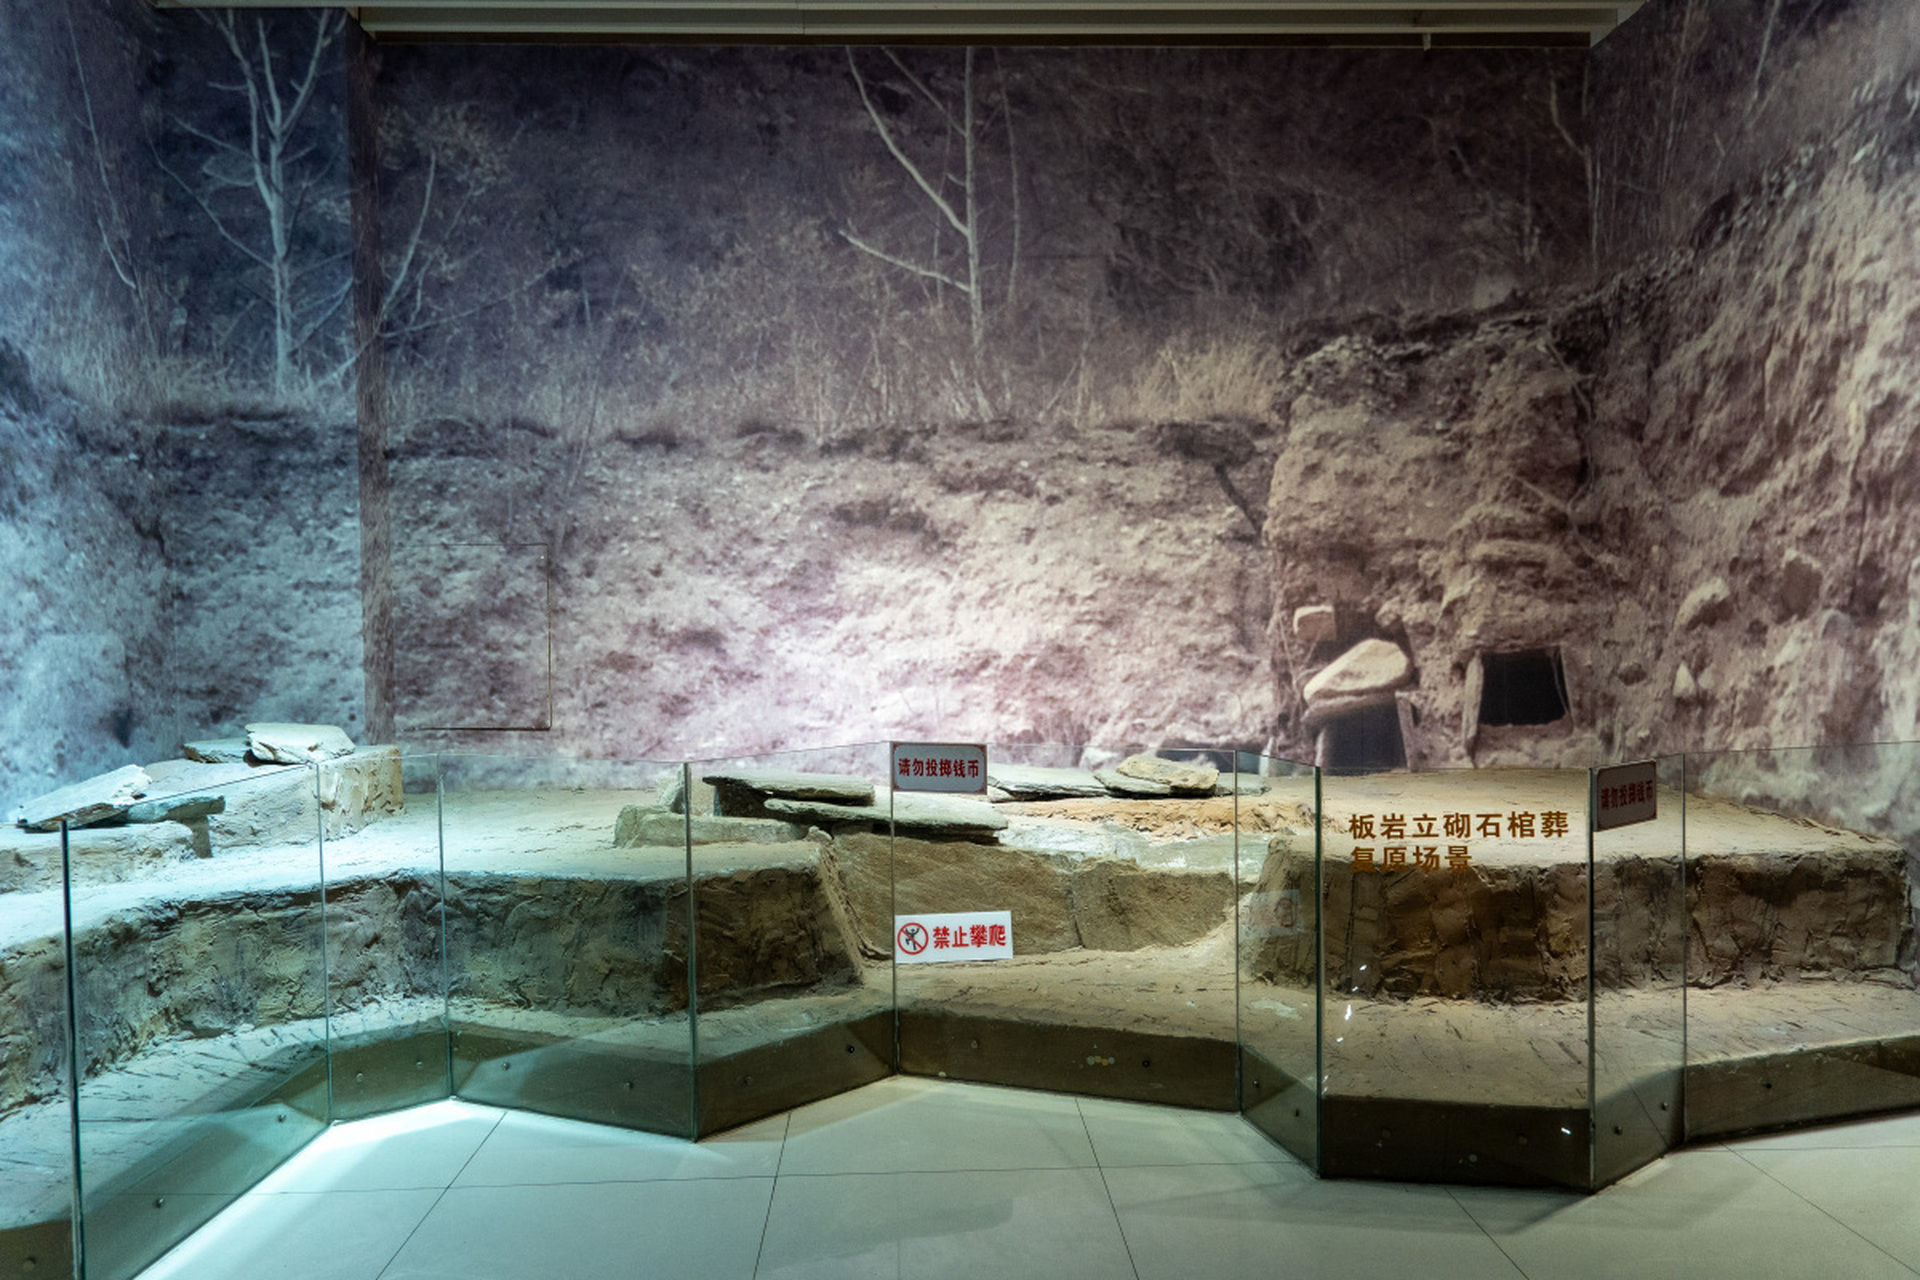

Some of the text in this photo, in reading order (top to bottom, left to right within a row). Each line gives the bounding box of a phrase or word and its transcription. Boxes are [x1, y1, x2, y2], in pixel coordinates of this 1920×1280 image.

[898, 758, 979, 778] 请勿投掷钱币
[1349, 811, 1569, 839] 板岩立砌石棺葬
[1351, 845, 1472, 872] 复原场景
[933, 924, 1006, 949] 禁止攀爬
